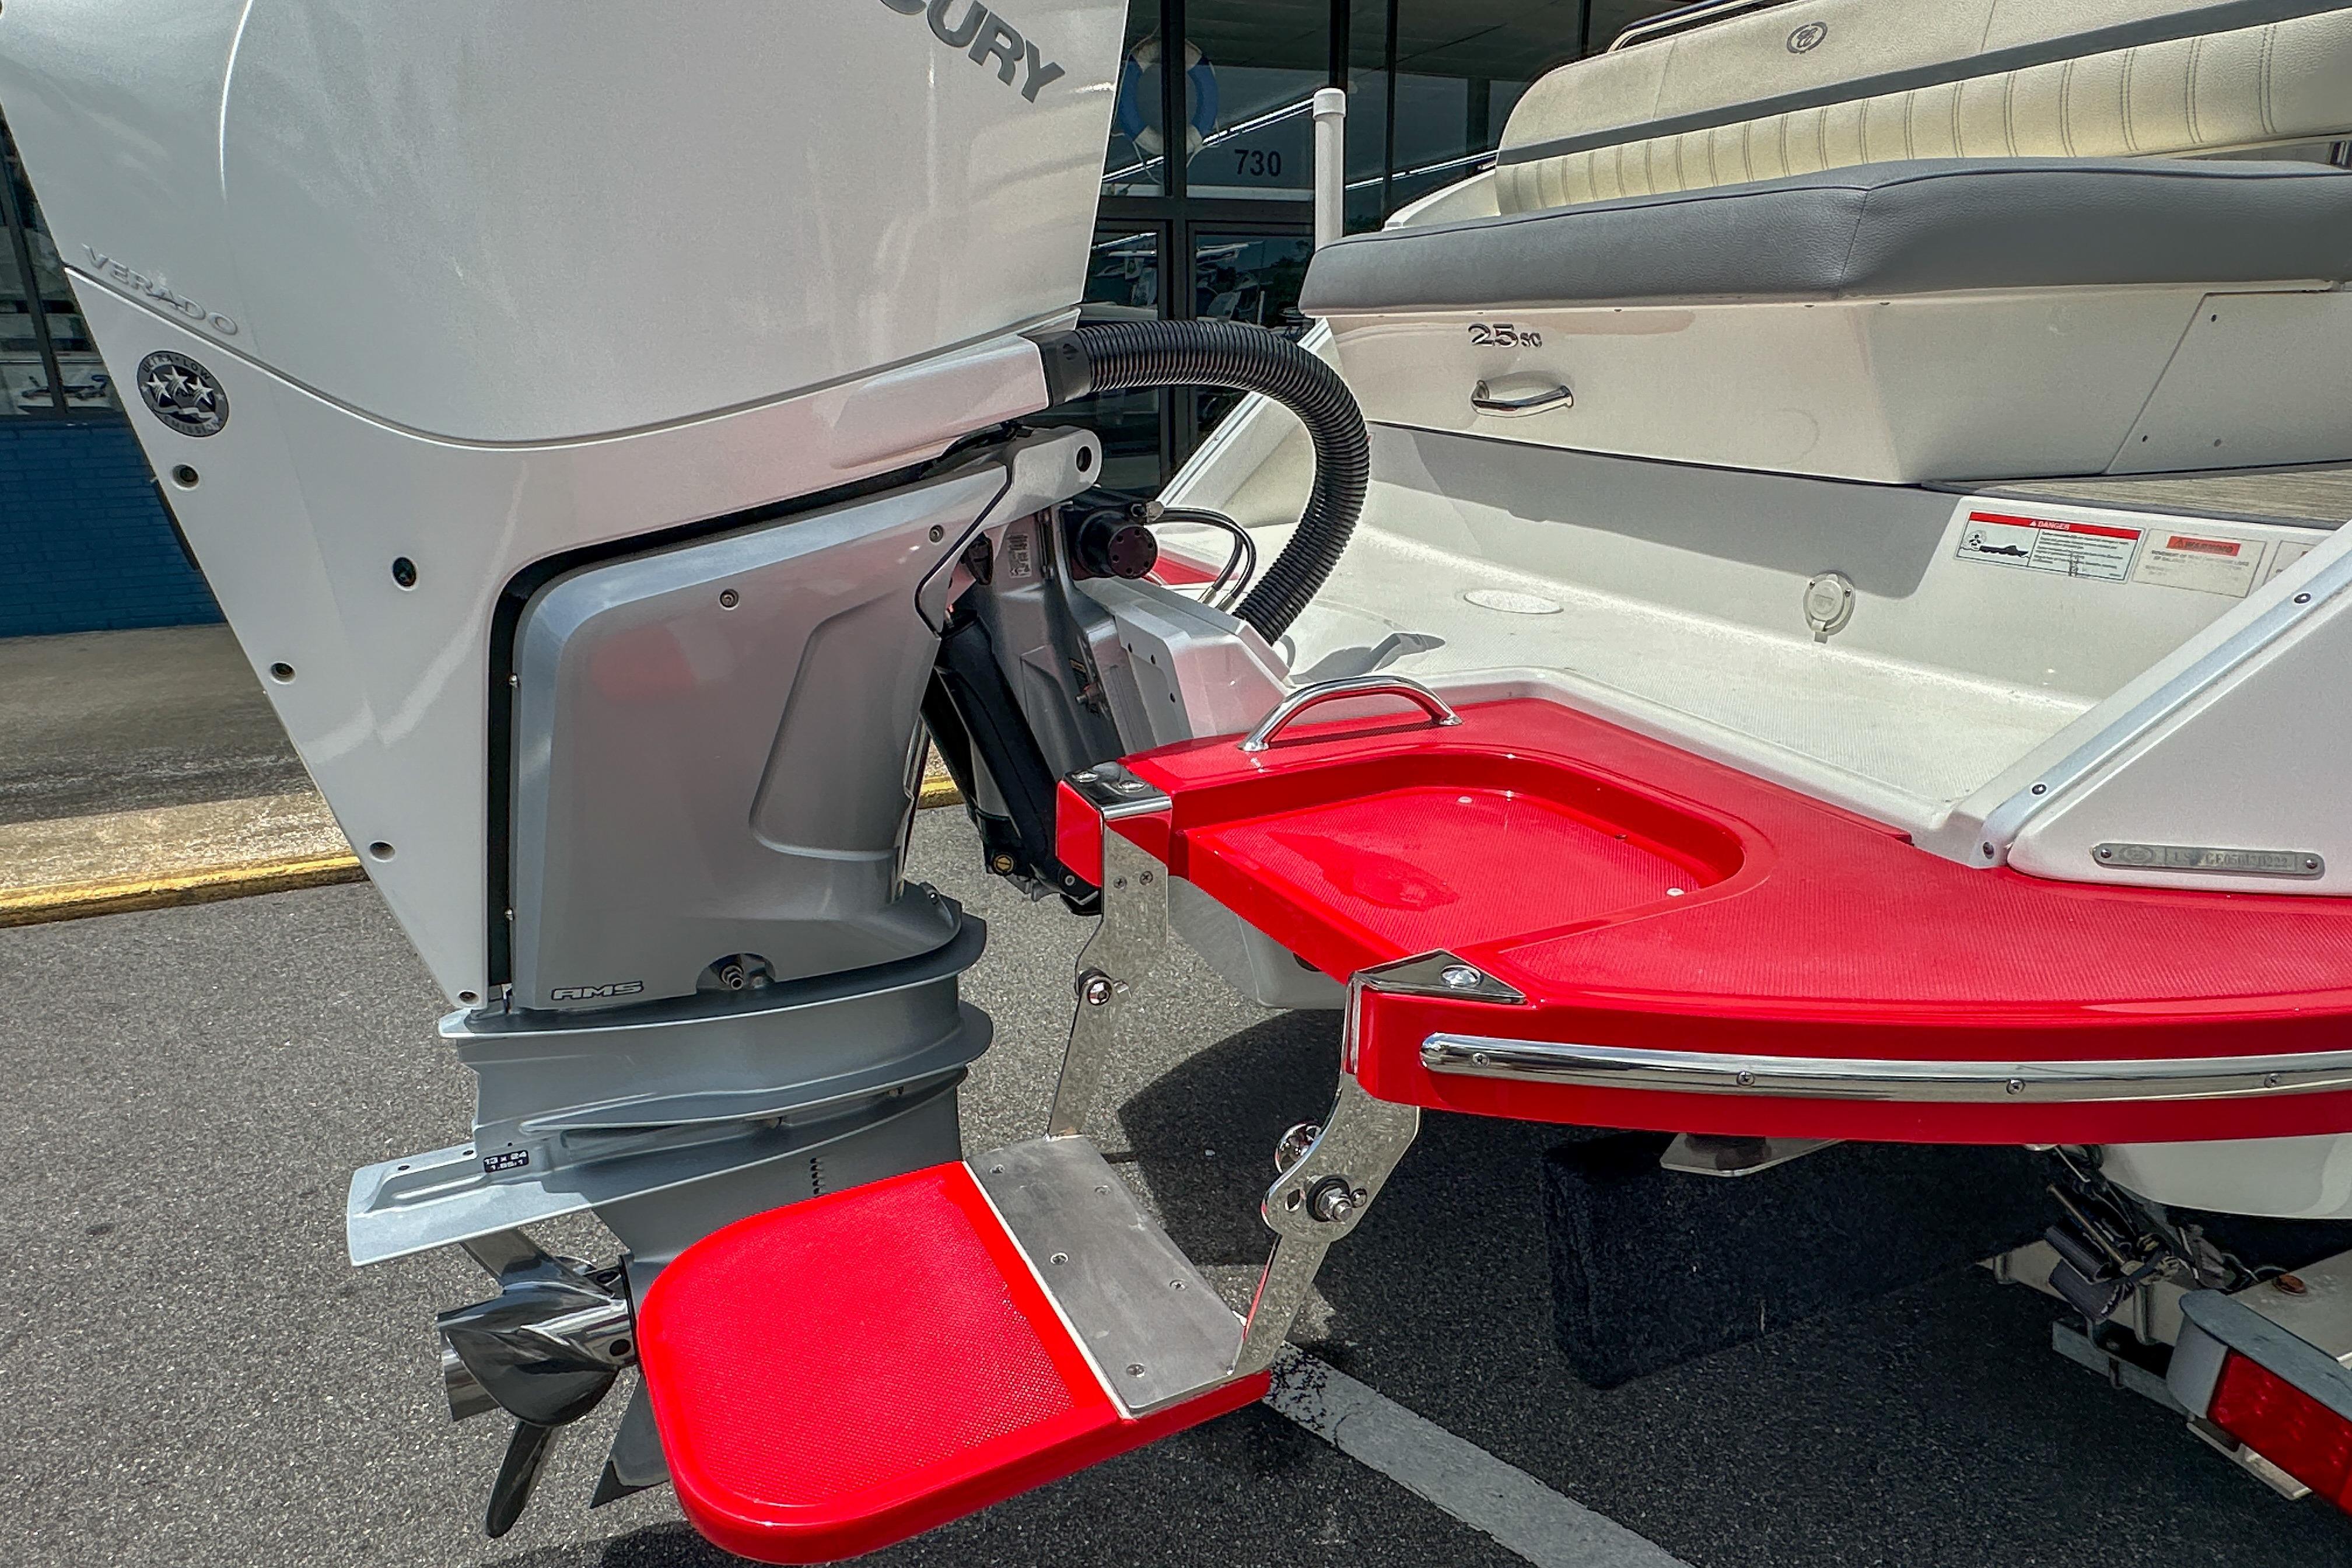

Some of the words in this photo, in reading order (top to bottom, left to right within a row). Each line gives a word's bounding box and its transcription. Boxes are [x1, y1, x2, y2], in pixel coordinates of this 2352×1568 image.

[880, 0, 1066, 103] URY
[1234, 148, 1282, 177] 730
[81, 243, 238, 335] VERADO
[2037, 520, 2071, 530] DANGER
[551, 980, 644, 1000] AMS
